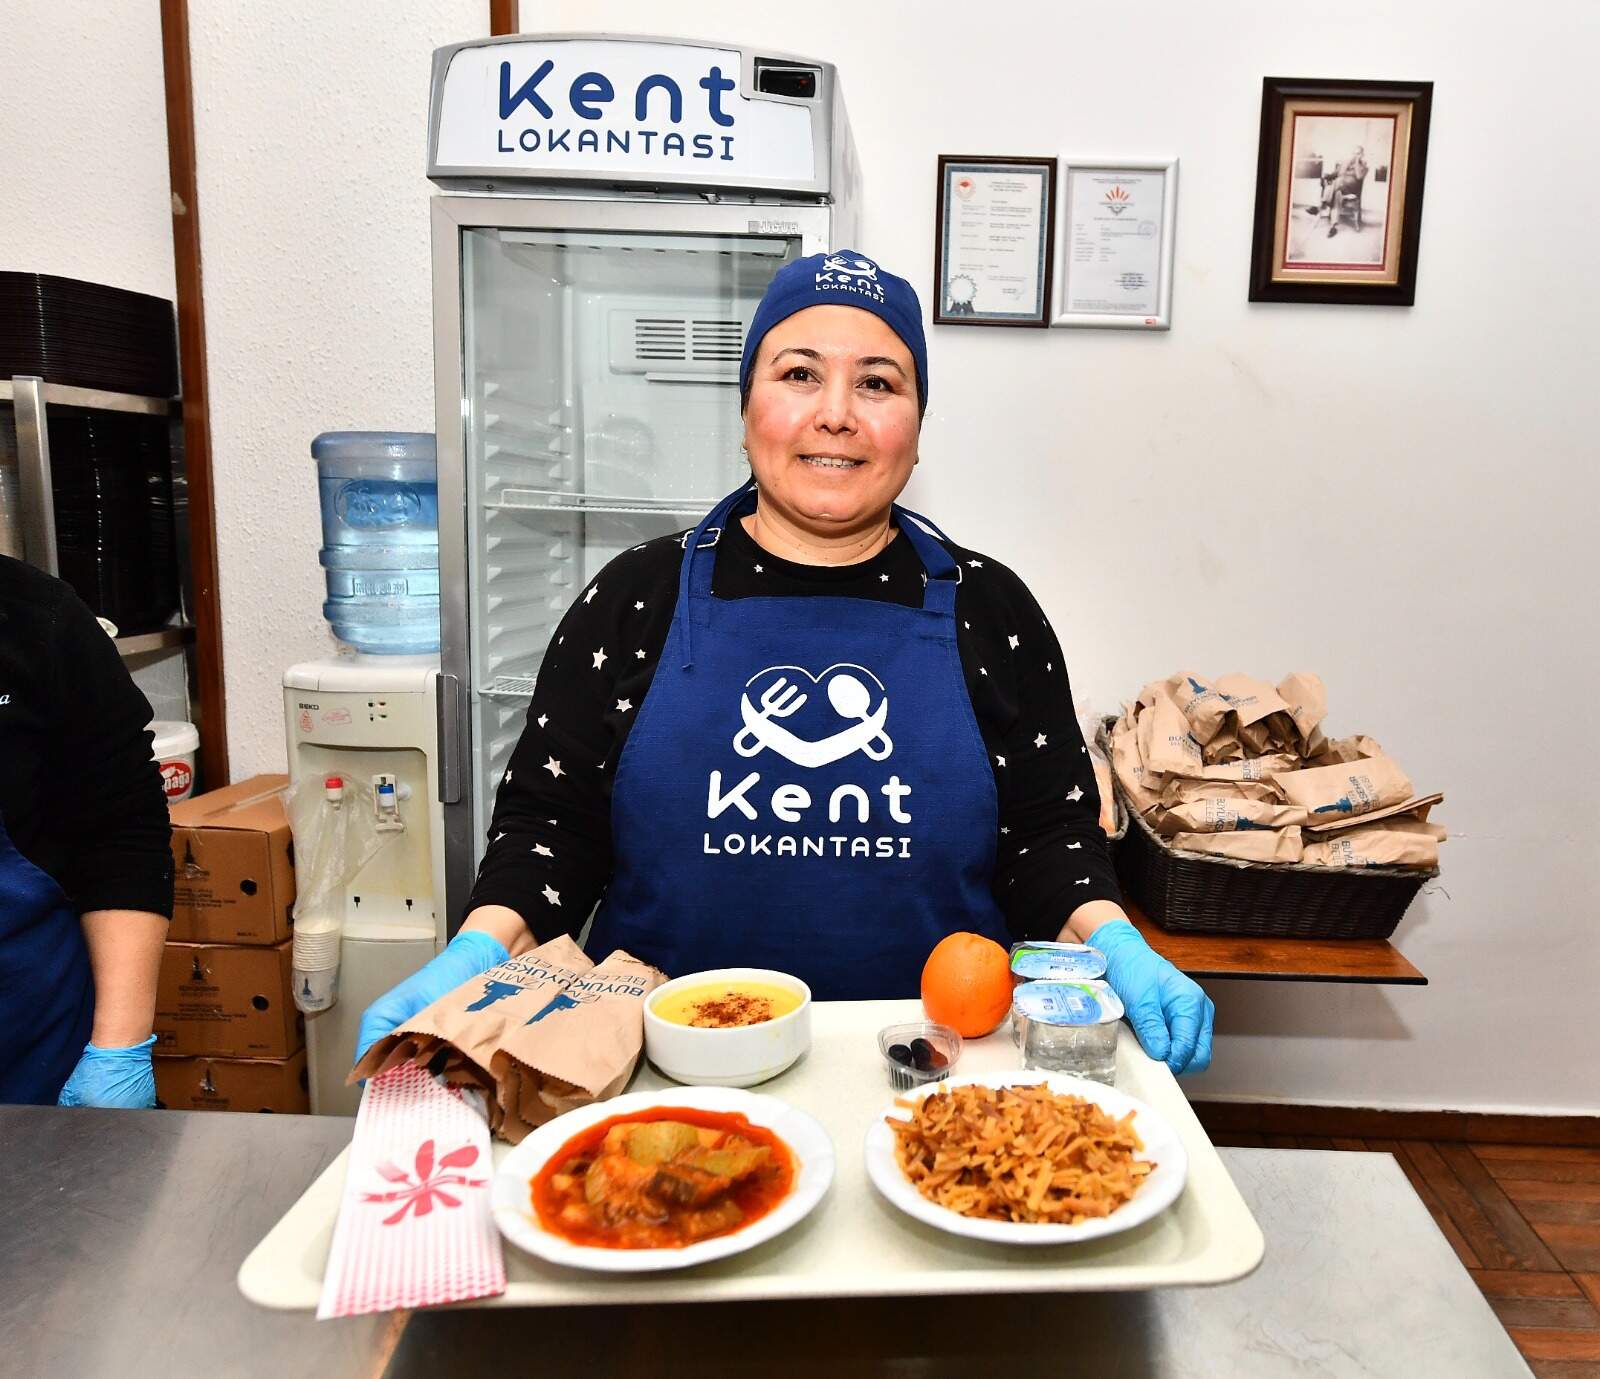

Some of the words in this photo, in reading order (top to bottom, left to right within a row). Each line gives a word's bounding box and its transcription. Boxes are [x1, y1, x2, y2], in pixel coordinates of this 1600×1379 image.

[500, 59, 735, 127] Kent
[498, 128, 735, 161] LOKANTASI
[815, 272, 885, 296] Kent
[815, 284, 885, 304] LOKANTASI
[162, 769, 190, 793] pağa
[707, 770, 912, 824] Kent
[703, 832, 911, 858] LOKANTASI
